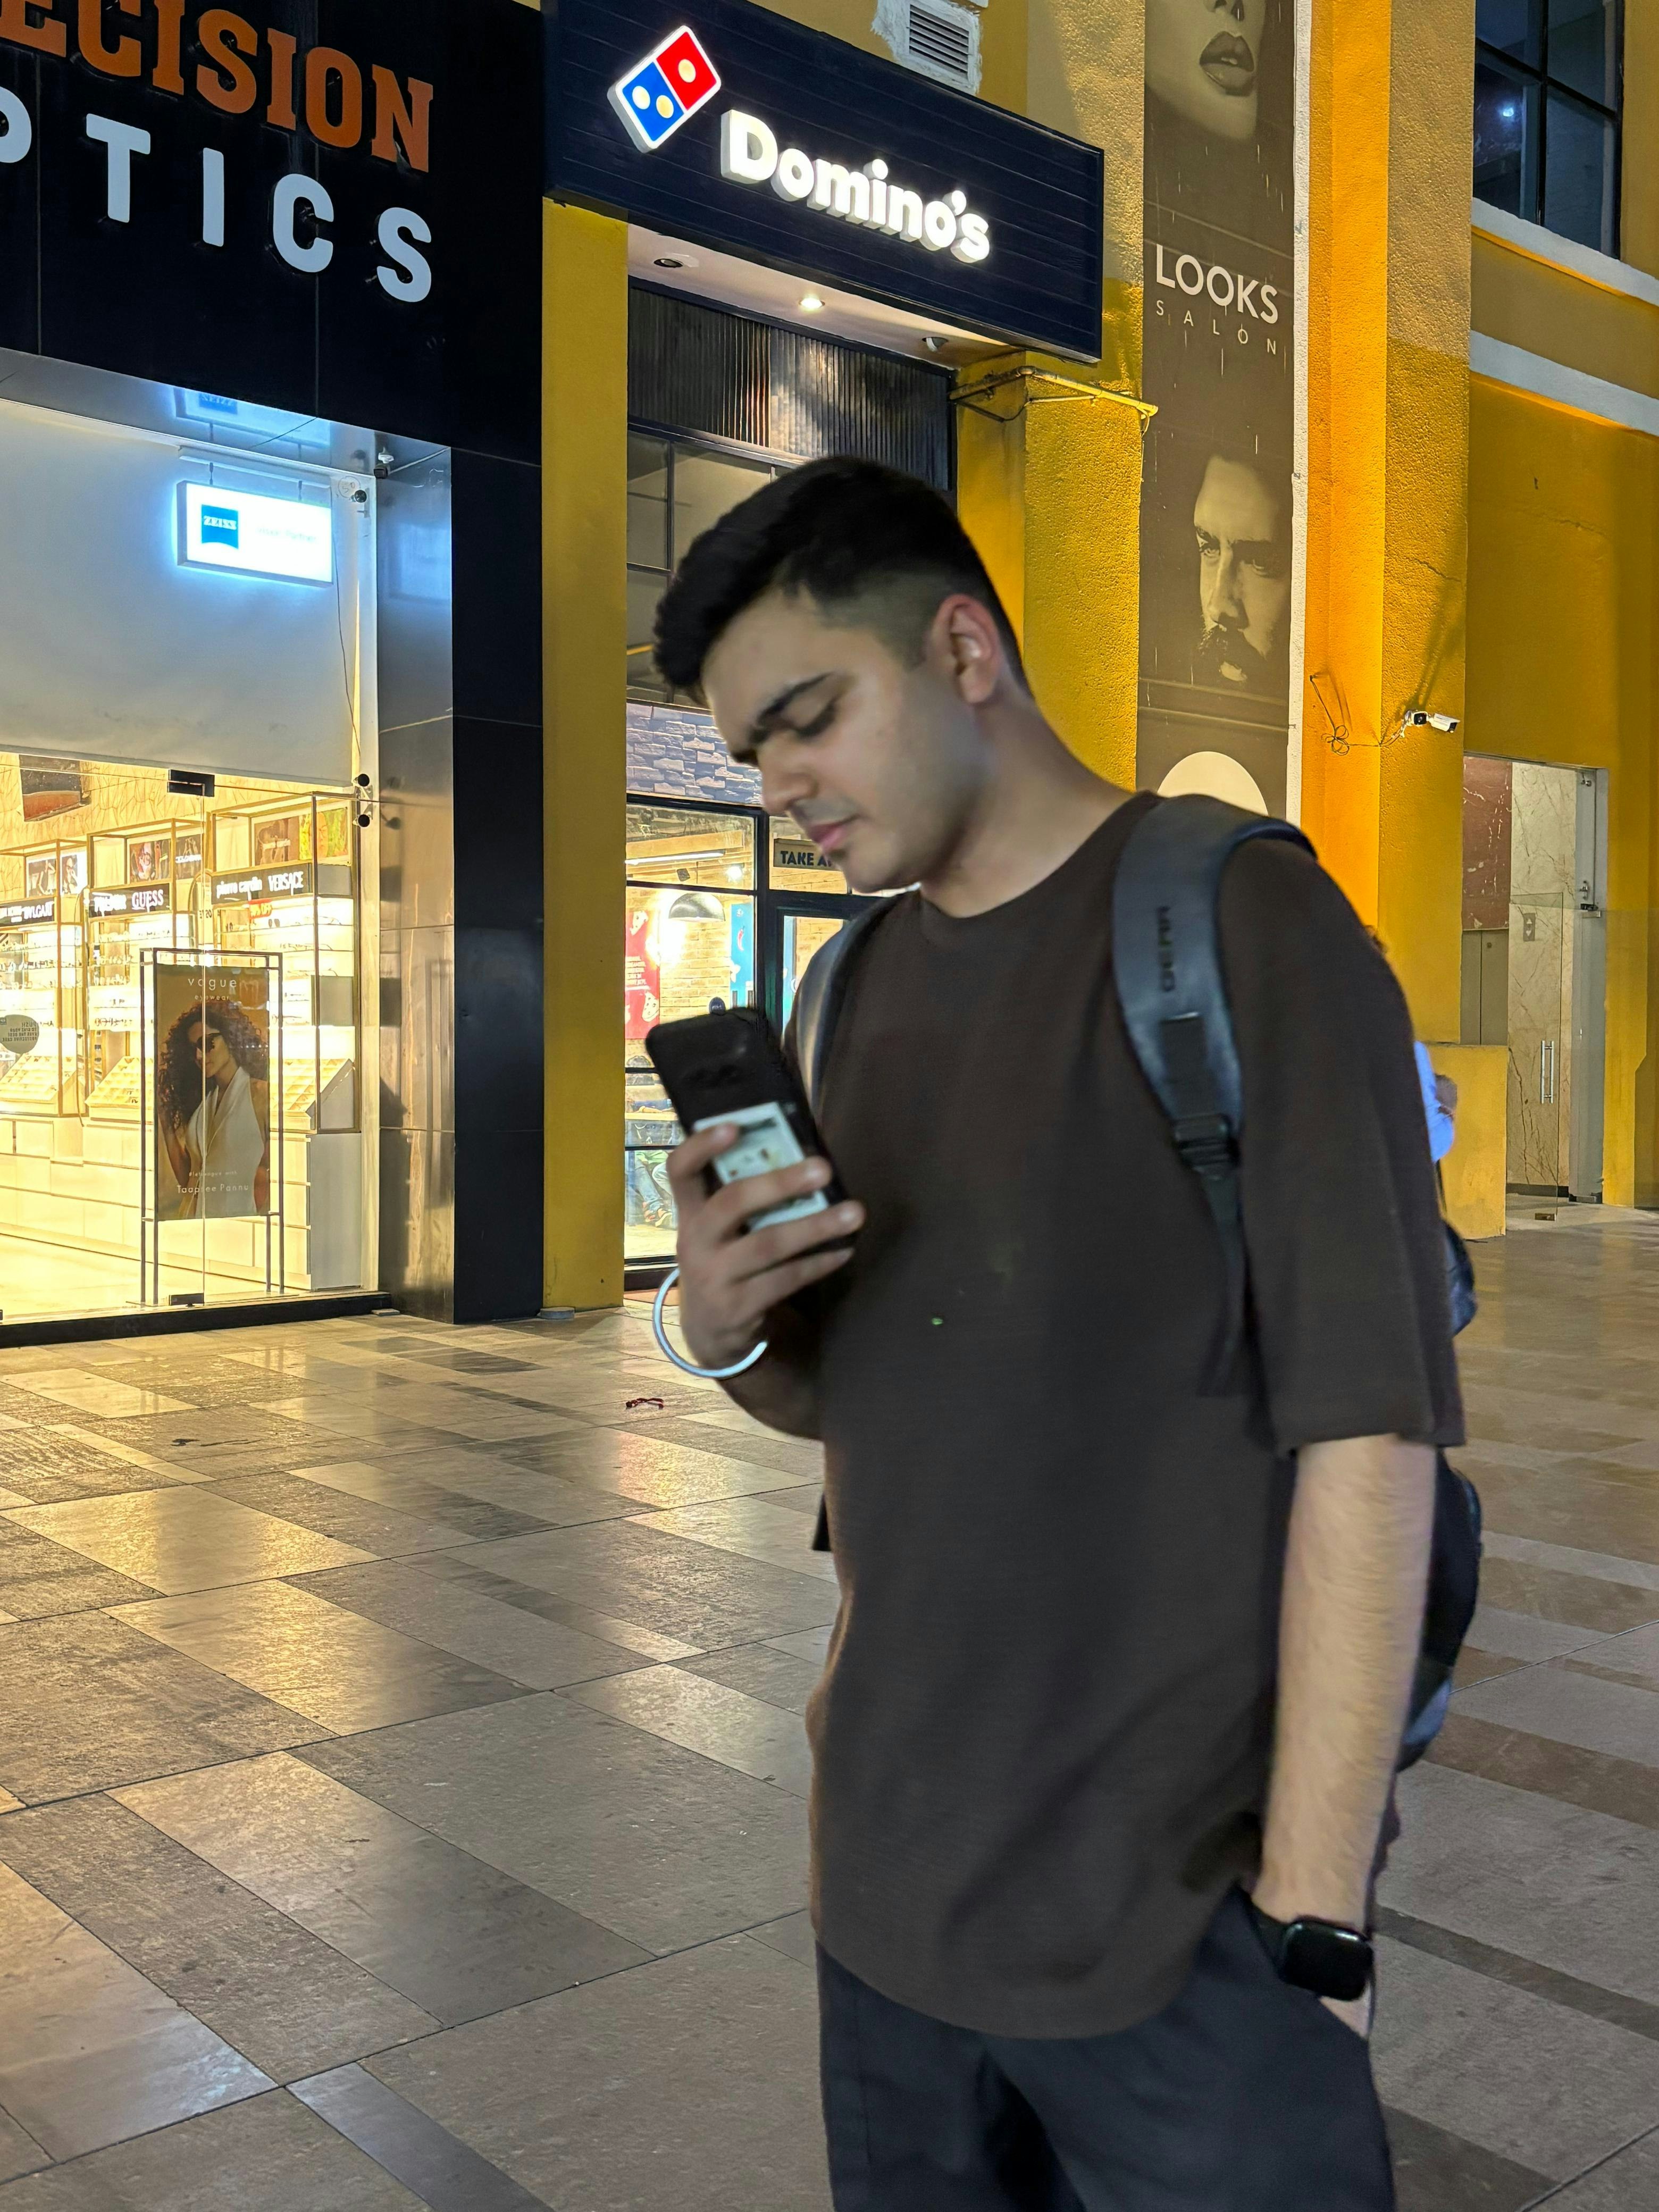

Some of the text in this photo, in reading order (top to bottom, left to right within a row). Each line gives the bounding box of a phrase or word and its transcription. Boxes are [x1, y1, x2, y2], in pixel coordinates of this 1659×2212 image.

[722, 110, 990, 263] Domino's
[1156, 243, 1278, 324] LOOKS
[1156, 300, 1276, 355] SALON
[203, 515, 237, 530] ZEISS
[780, 851, 814, 866] TAKE
[131, 889, 164, 908] GUESS
[188, 978, 237, 991] vogue
[220, 1184, 249, 1192] Pannu
